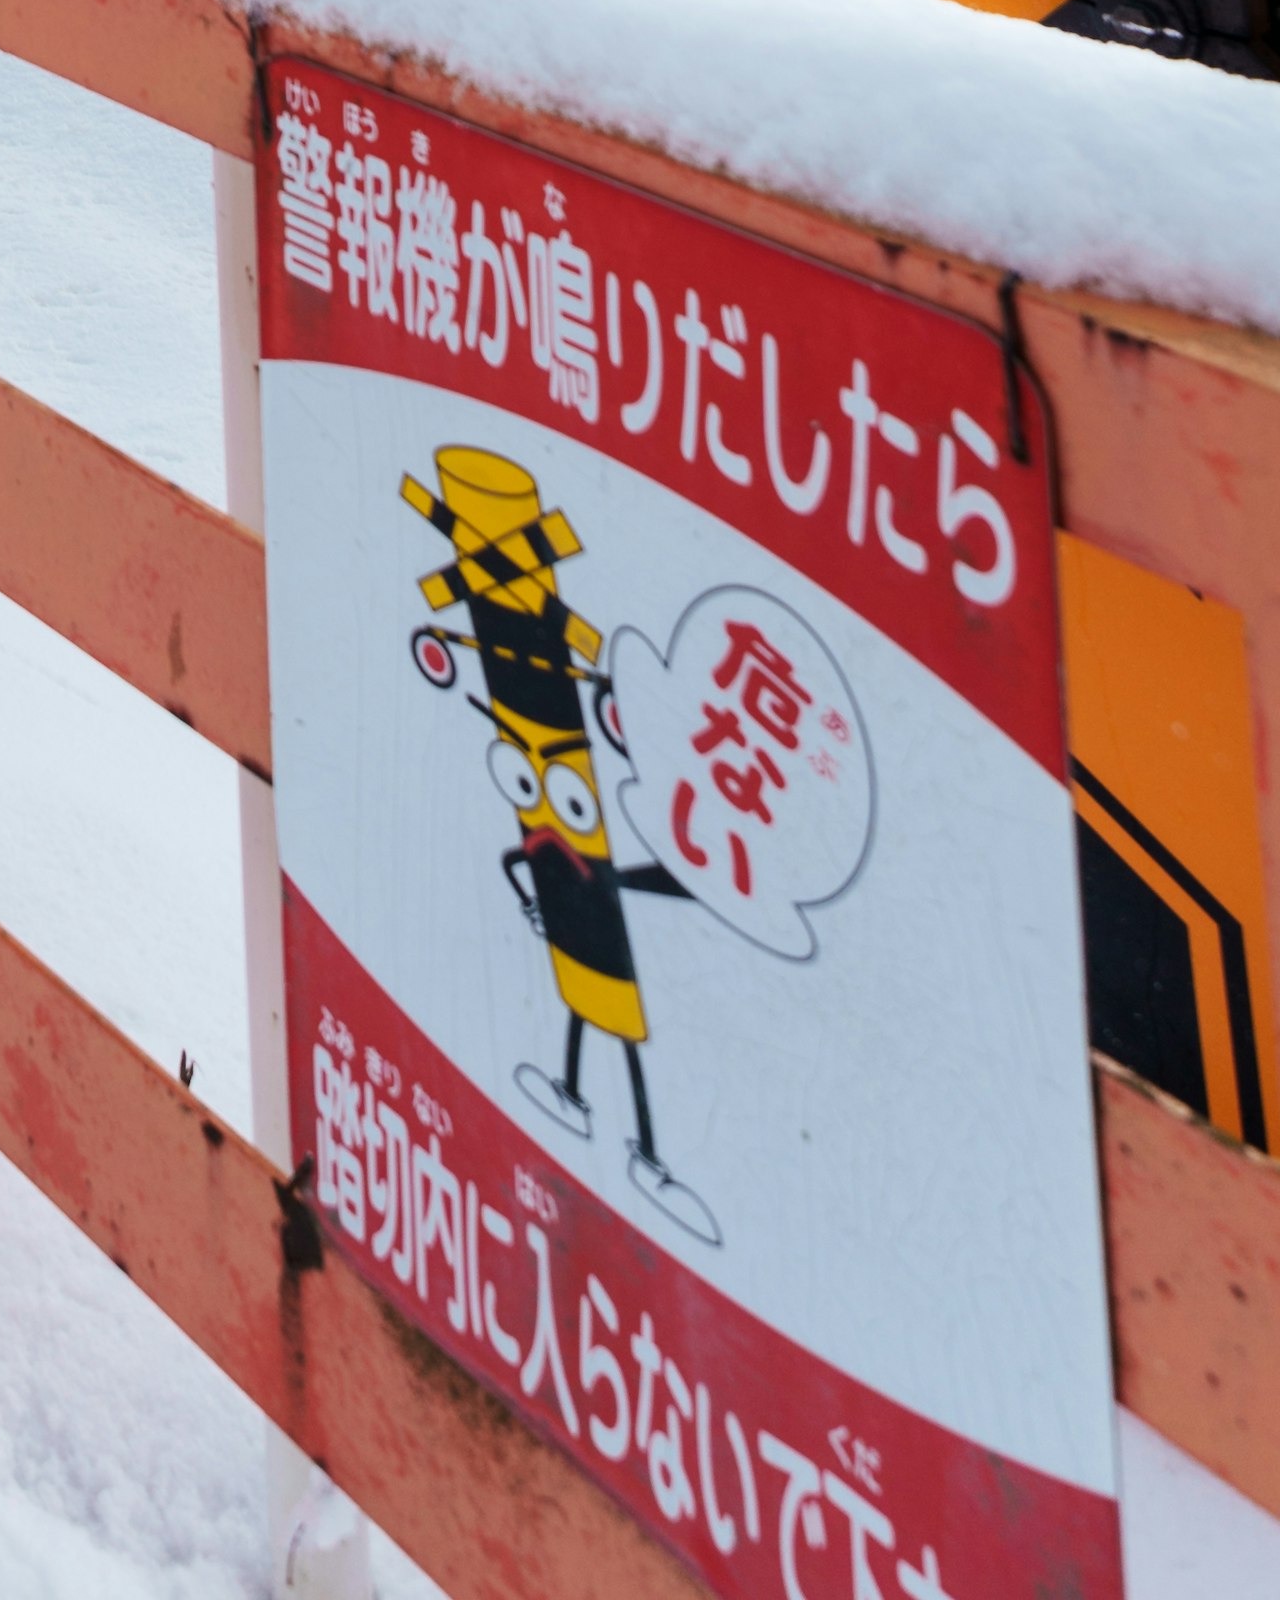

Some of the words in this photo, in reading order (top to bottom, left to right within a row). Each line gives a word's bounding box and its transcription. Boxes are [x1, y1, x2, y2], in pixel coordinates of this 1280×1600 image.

[343, 100, 379, 142] ほう
[277, 111, 1017, 605] 警報機が鳴りだしたら
[671, 619, 814, 897] 危ない
